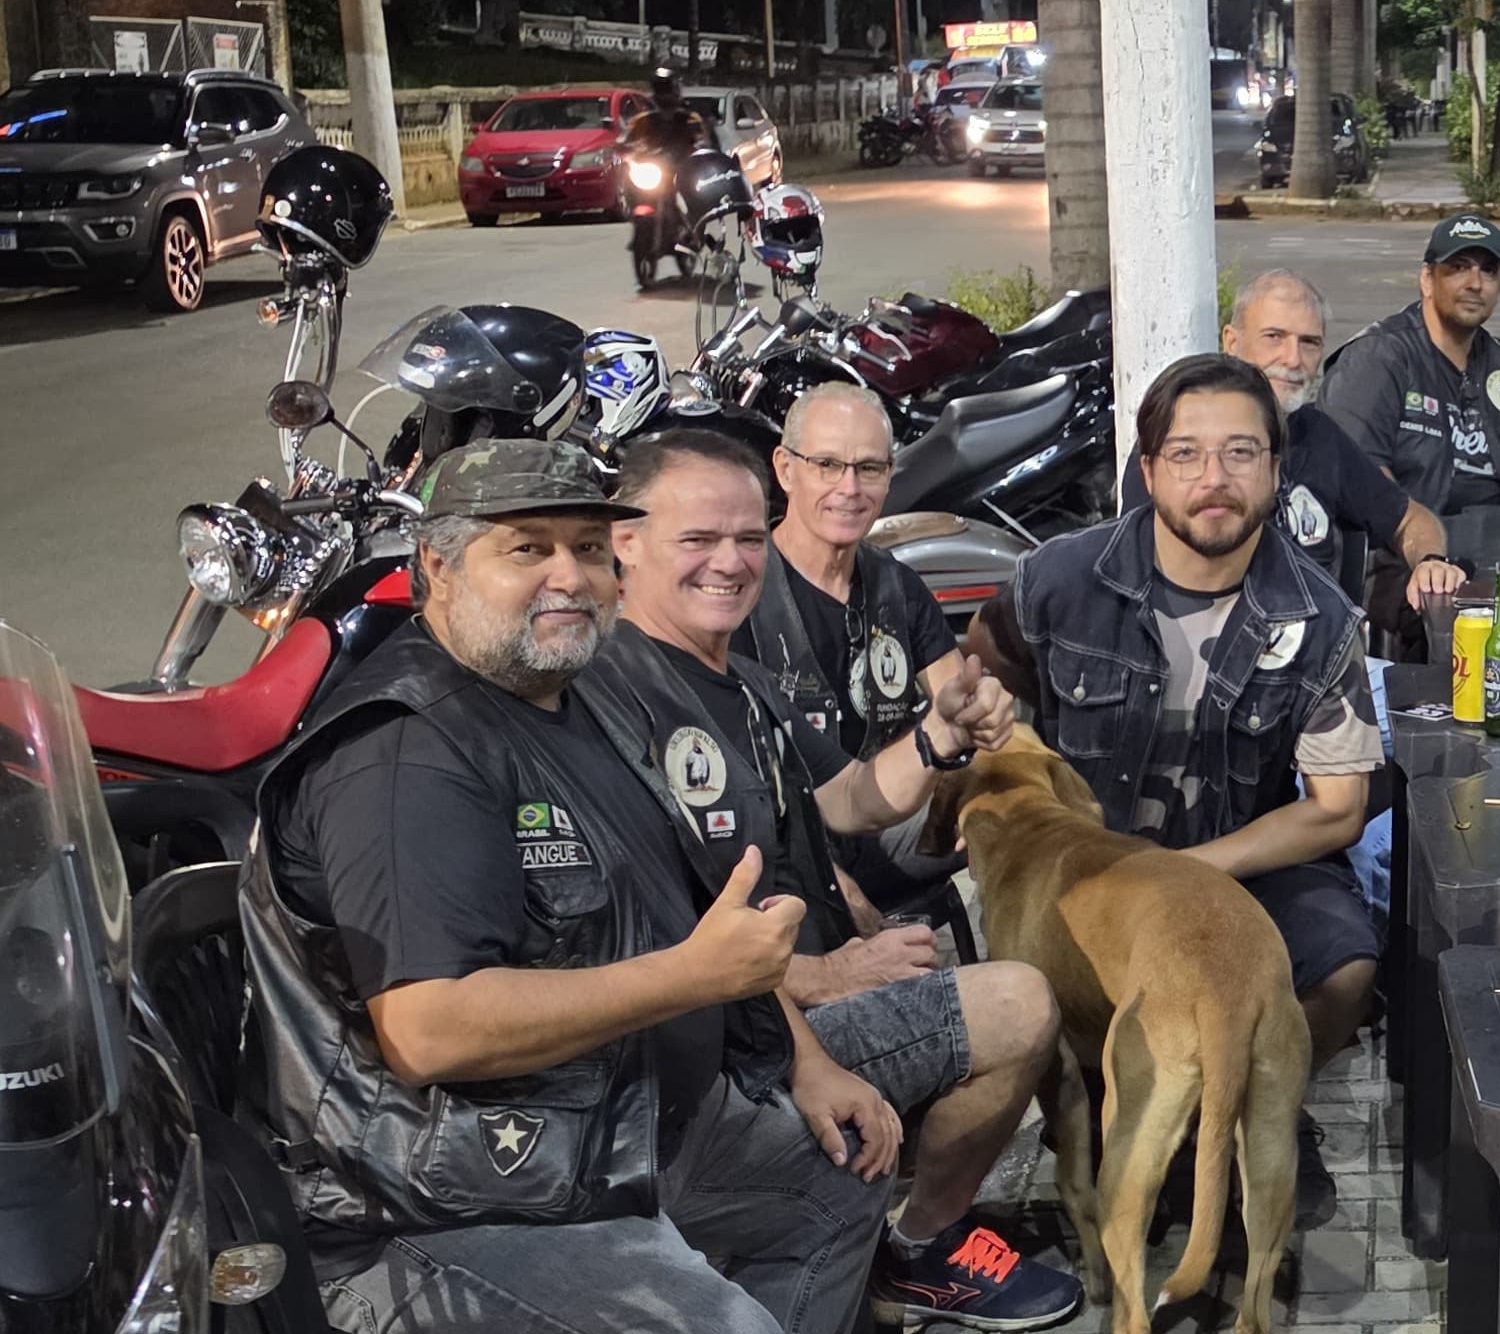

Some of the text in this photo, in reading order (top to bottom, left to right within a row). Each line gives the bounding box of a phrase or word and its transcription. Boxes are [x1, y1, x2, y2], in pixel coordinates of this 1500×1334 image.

[1452, 655, 1471, 678] OL
[516, 828, 551, 838] BRASIL
[522, 845, 578, 864] ANGUE
